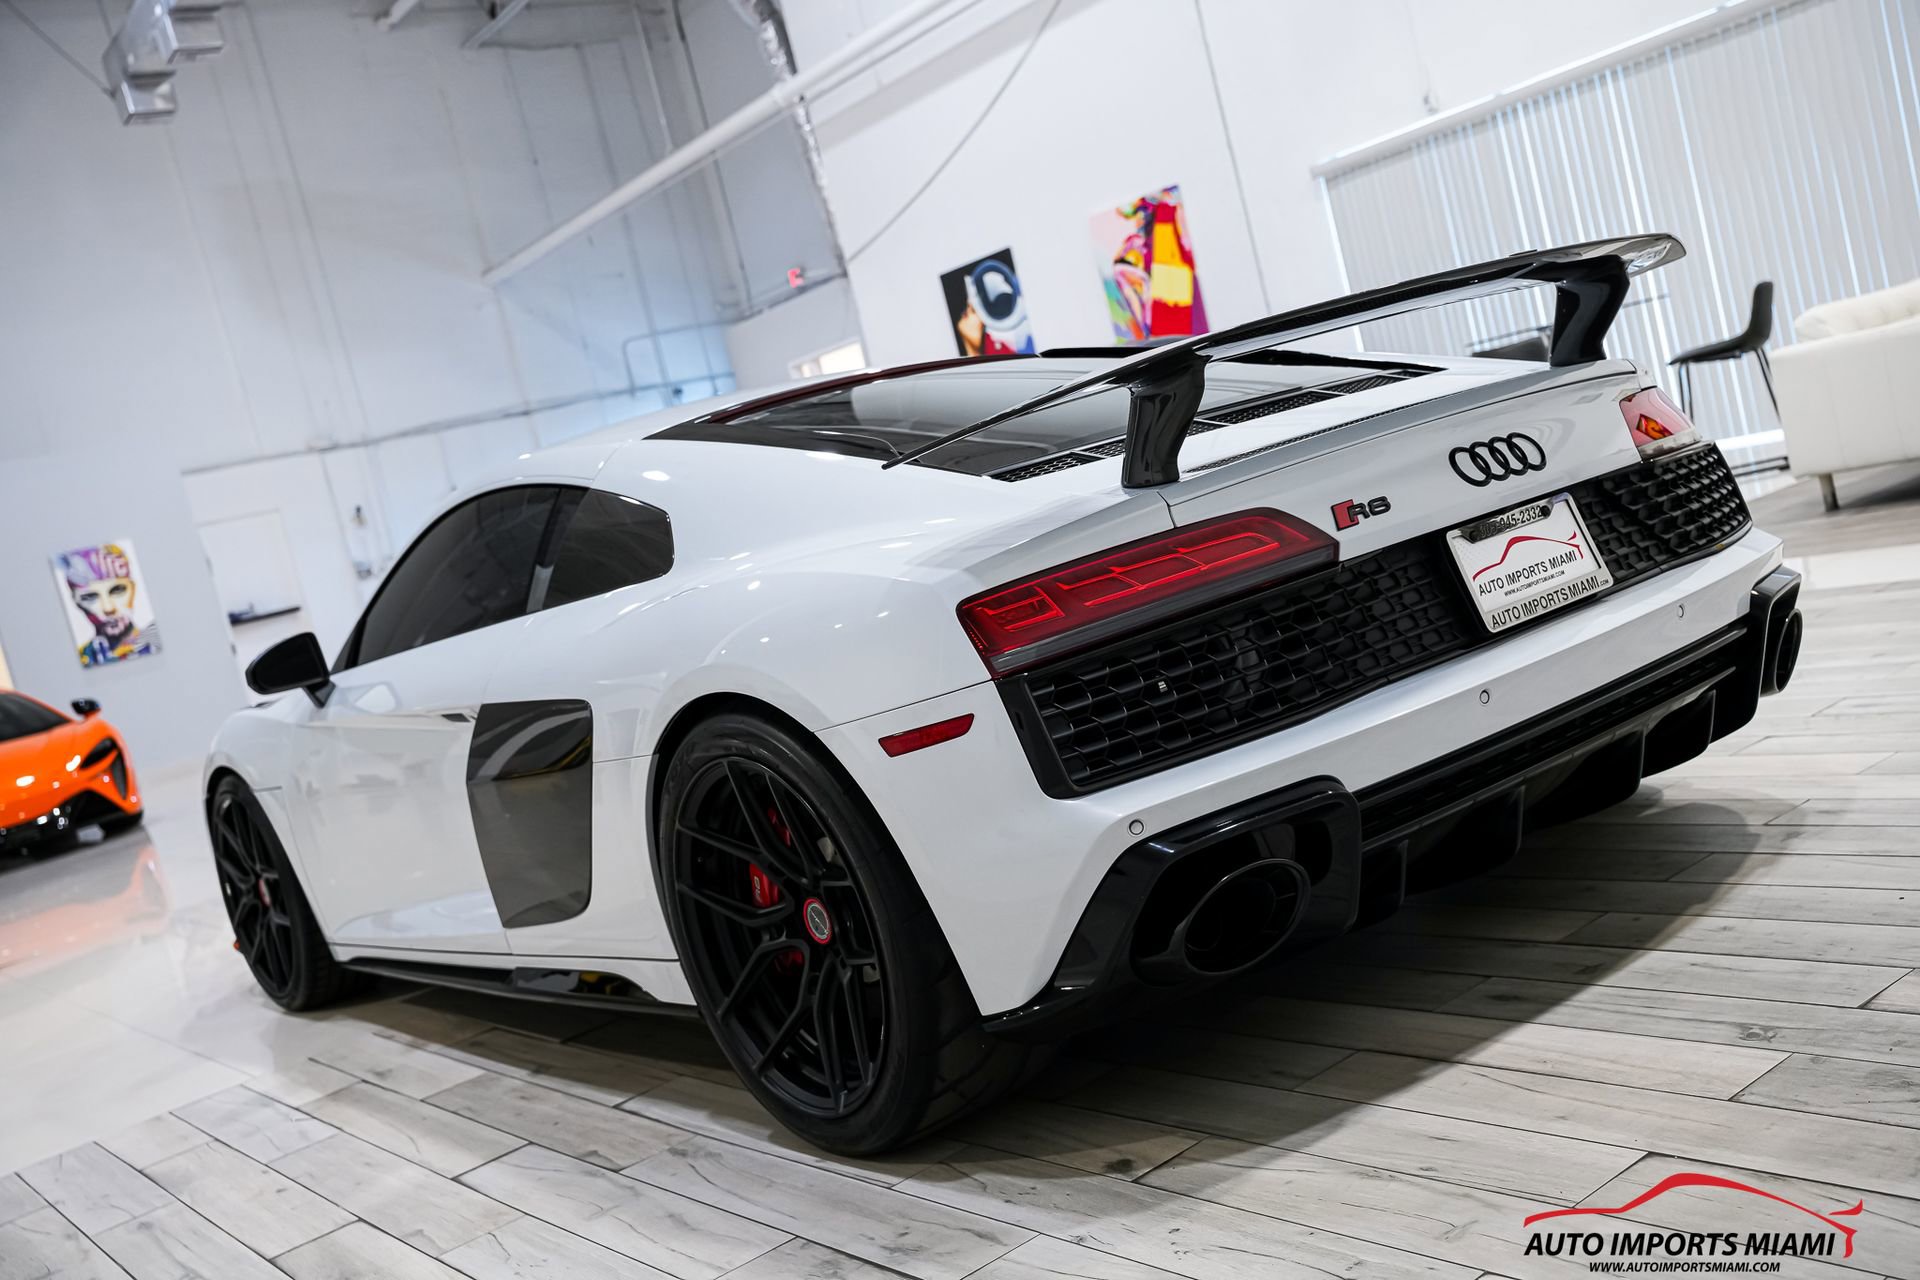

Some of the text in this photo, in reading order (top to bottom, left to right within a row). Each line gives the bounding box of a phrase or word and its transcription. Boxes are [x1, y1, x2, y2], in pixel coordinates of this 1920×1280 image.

[1346, 496, 1391, 523] R8
[1479, 550, 1577, 596] AUTO IMPORTS MIAMI
[1504, 569, 1566, 597] WWW.AUTOIMPORTSMIAMI.COM
[1491, 606, 1521, 628] AUTO
[1520, 588, 1569, 617] IMPORTS
